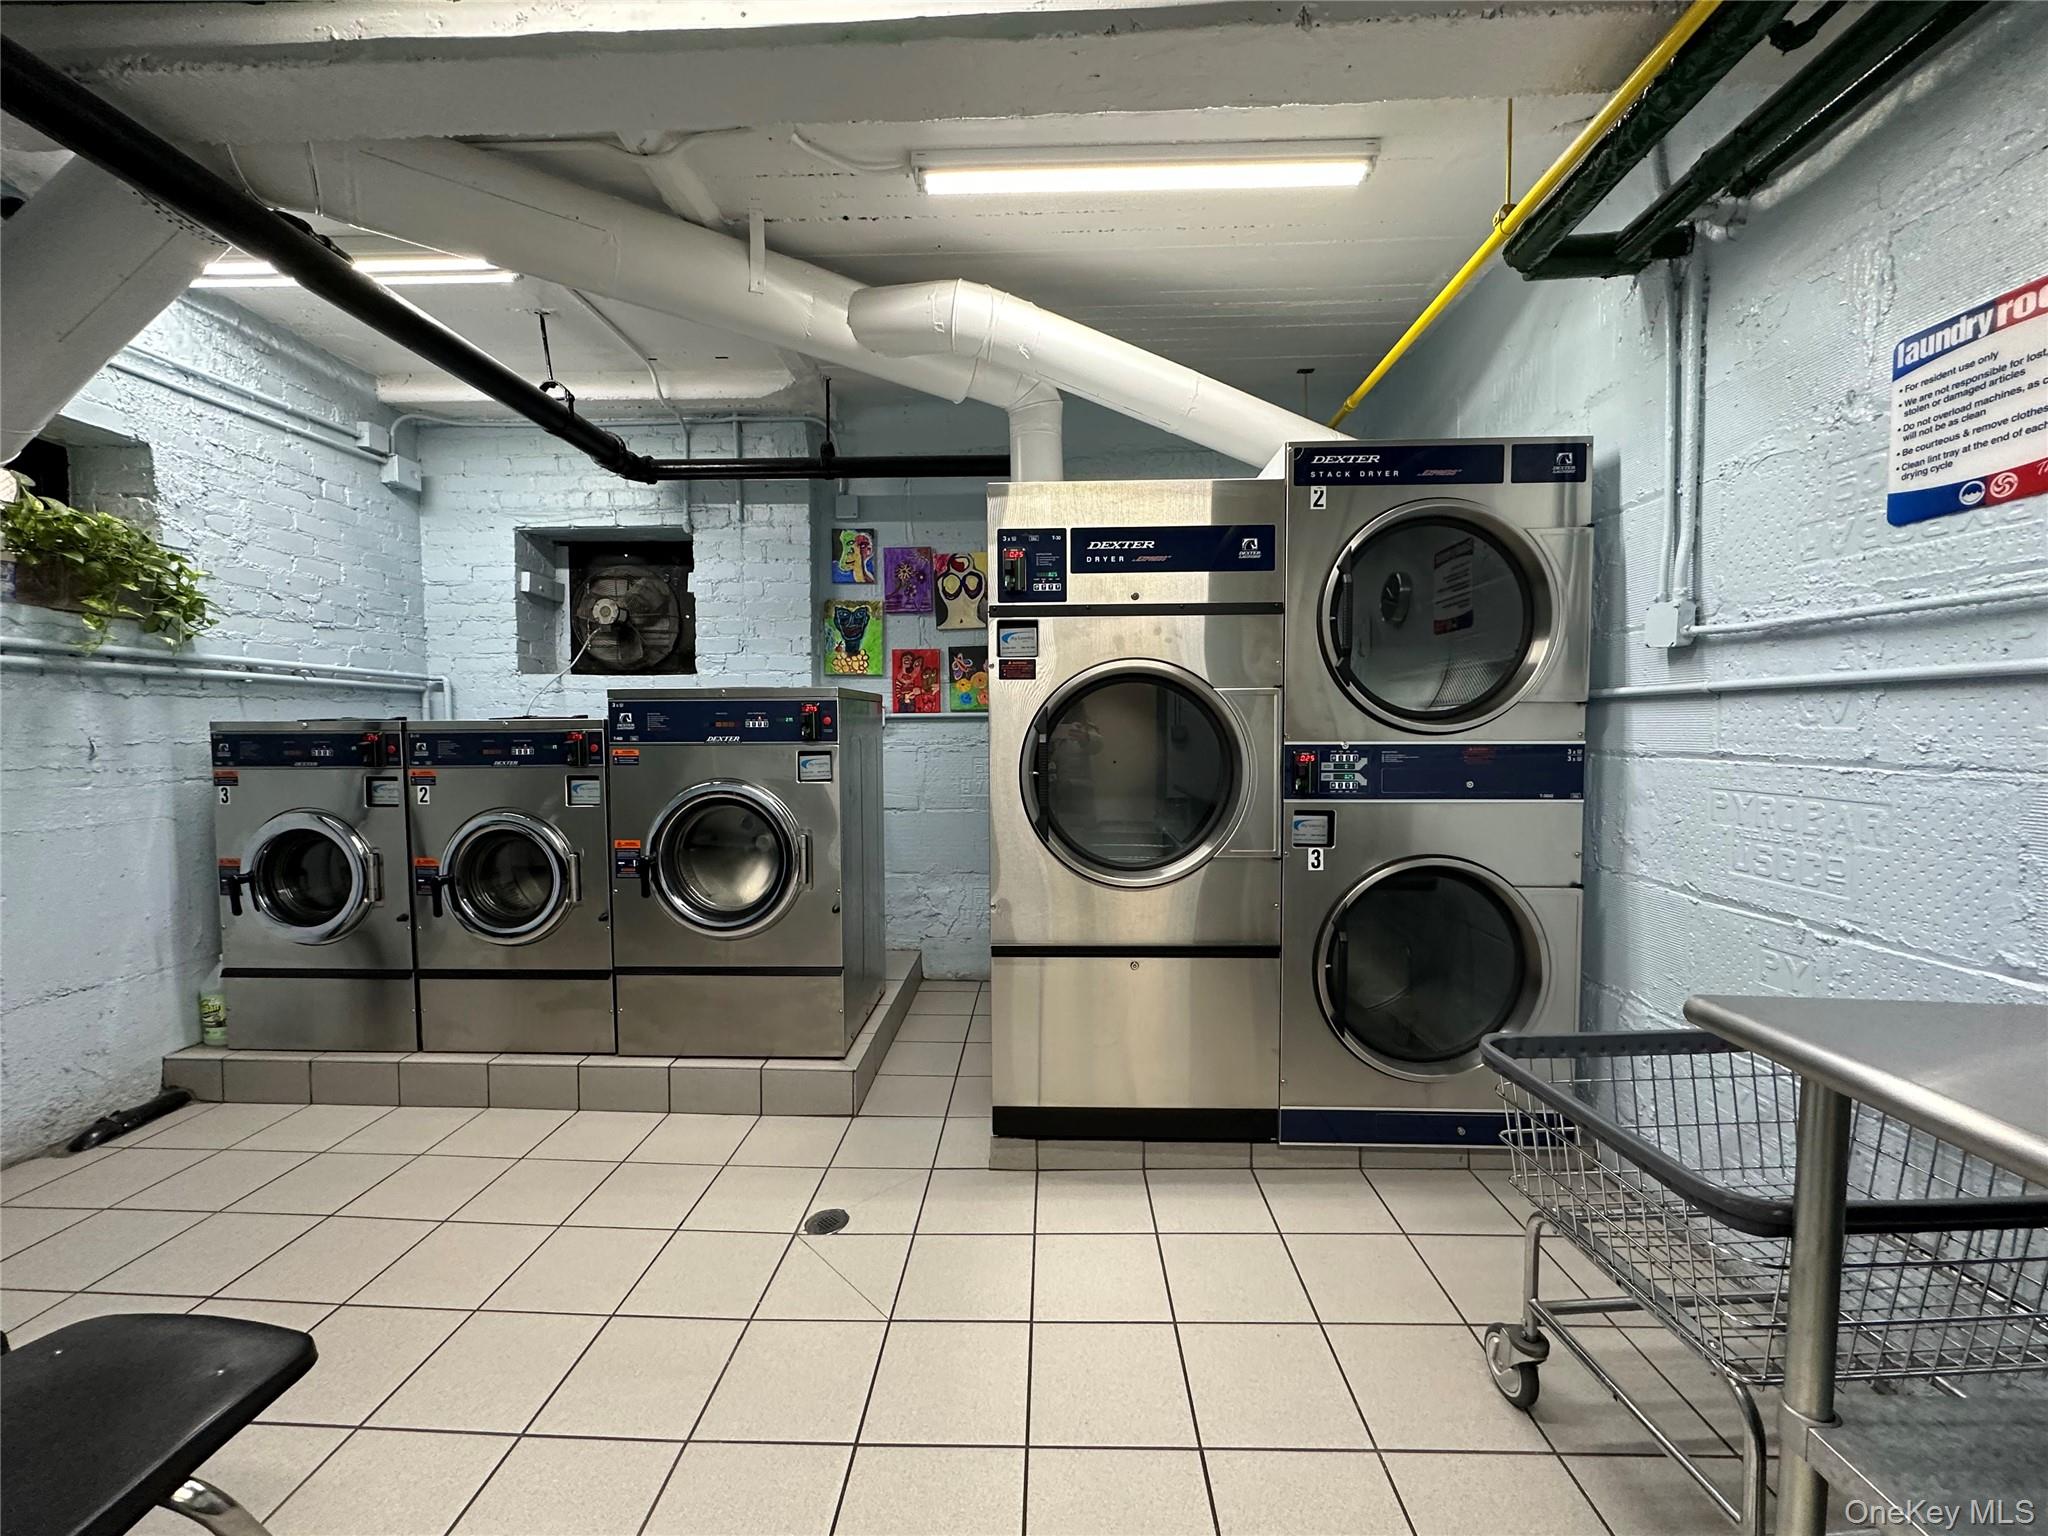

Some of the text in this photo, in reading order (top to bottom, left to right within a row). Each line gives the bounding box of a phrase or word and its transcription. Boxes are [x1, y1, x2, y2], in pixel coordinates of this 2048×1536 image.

[1897, 308, 1994, 368] laundry
[1904, 398, 1917, 407] We
[1919, 392, 1933, 402] are
[1935, 385, 1949, 396] not
[1951, 365, 2007, 390] responsible
[2010, 358, 2024, 368] for
[1905, 351, 1999, 392] For resident use only
[1903, 423, 1915, 432] Do
[1917, 416, 1931, 427] not
[1933, 402, 1971, 421] overload
[1974, 386, 2025, 408] machines,
[2027, 380, 2040, 390] as
[1904, 369, 2026, 417] stolen or damaged articles
[1902, 448, 1913, 456] Be
[1915, 433, 1960, 452] courteous
[1963, 429, 1970, 438] &
[1972, 418, 2009, 435] remove
[1903, 409, 1986, 441] will not be as clean
[1311, 454, 1380, 464] DEXTER
[1901, 459, 1925, 471] Clean
[1927, 453, 1941, 463] lint
[1943, 448, 1960, 459] tray
[1962, 444, 1971, 453] at
[1973, 440, 1989, 450] the
[1990, 432, 2010, 445] end
[2012, 427, 2023, 438] of
[1901, 461, 1953, 480] drying cycle
[1313, 489, 1325, 508] 2
[1087, 540, 1155, 549] DEXTER
[221, 787, 229, 803] 3
[419, 787, 428, 803] 2
[1311, 849, 1320, 868] 3
